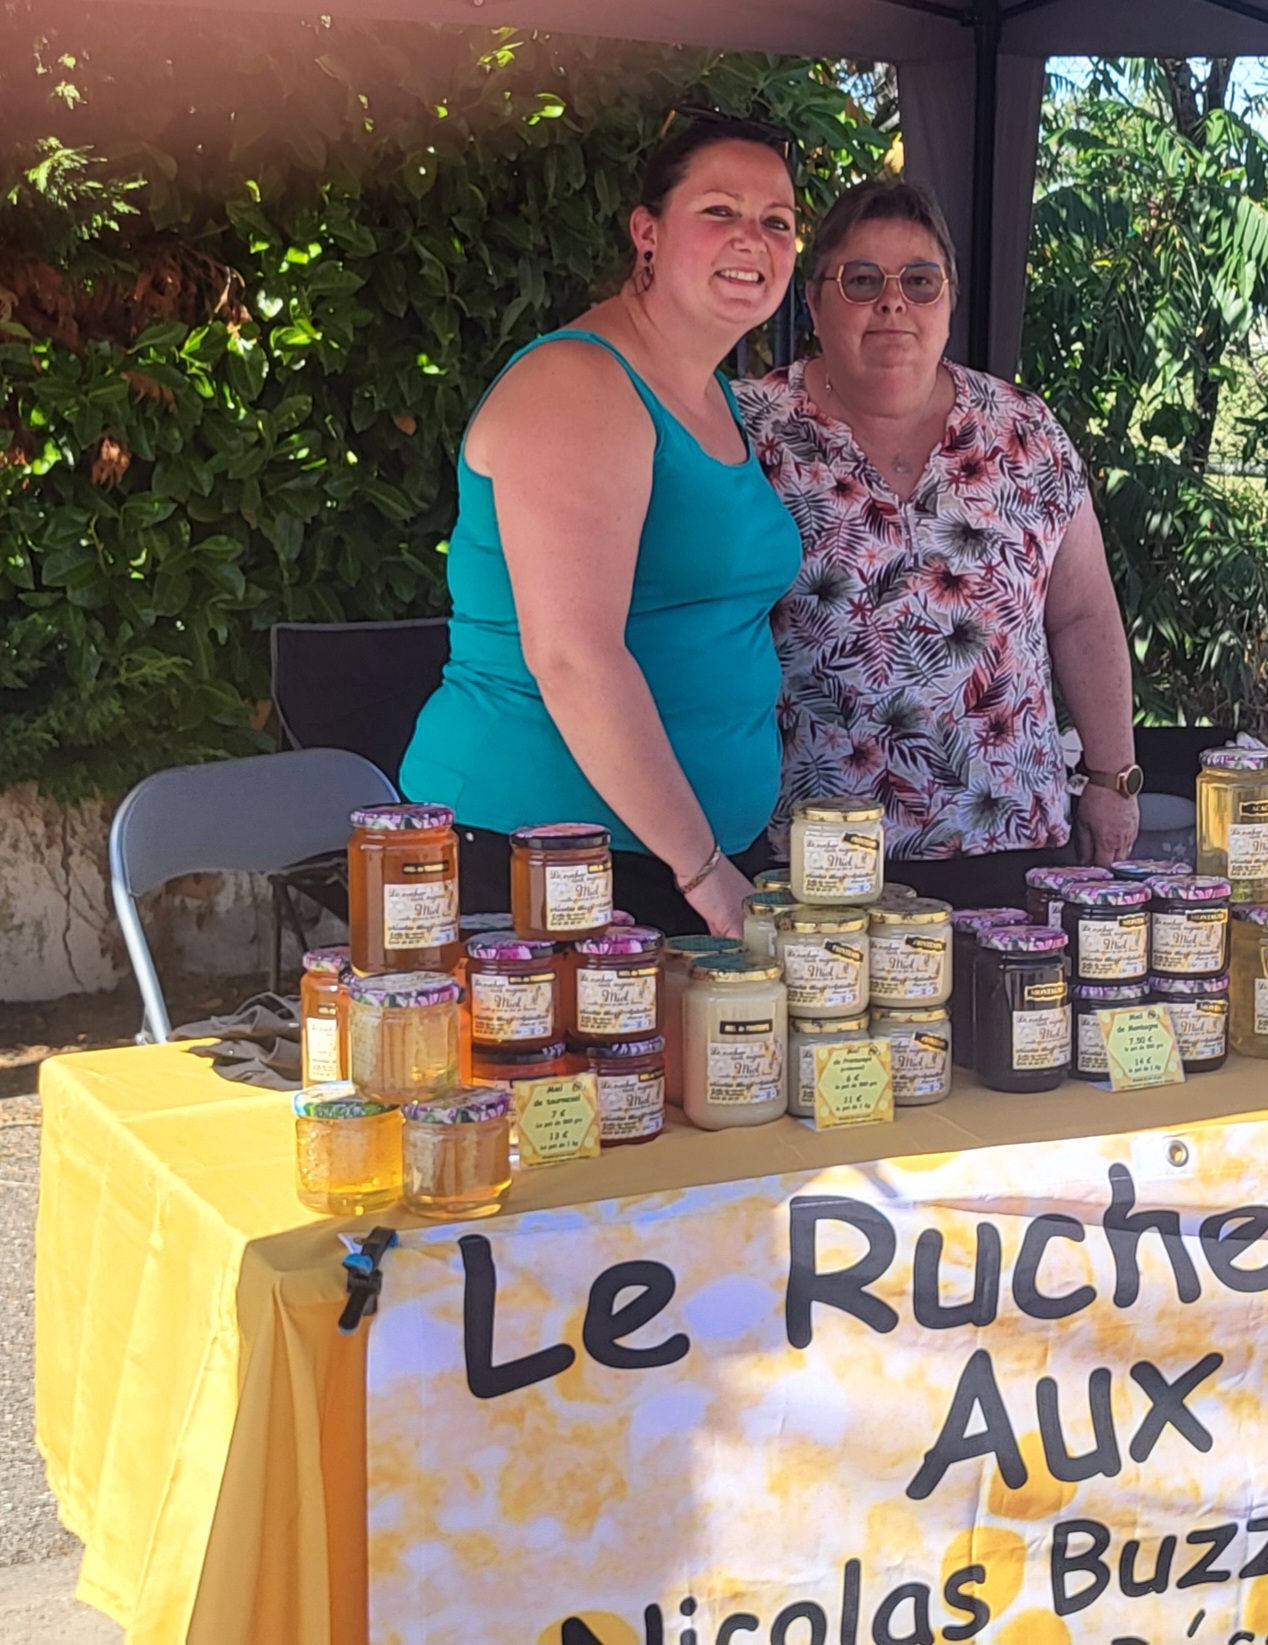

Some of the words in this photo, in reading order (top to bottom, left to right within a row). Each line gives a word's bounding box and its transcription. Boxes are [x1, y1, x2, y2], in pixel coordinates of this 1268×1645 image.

[1146, 1056, 1152, 1064] €
[853, 1073, 860, 1081] €
[856, 1094, 862, 1102] €
[551, 1110, 558, 1119] 7
[560, 1109, 566, 1117] €
[562, 1130, 569, 1138] €
[457, 1234, 691, 1400] Le
